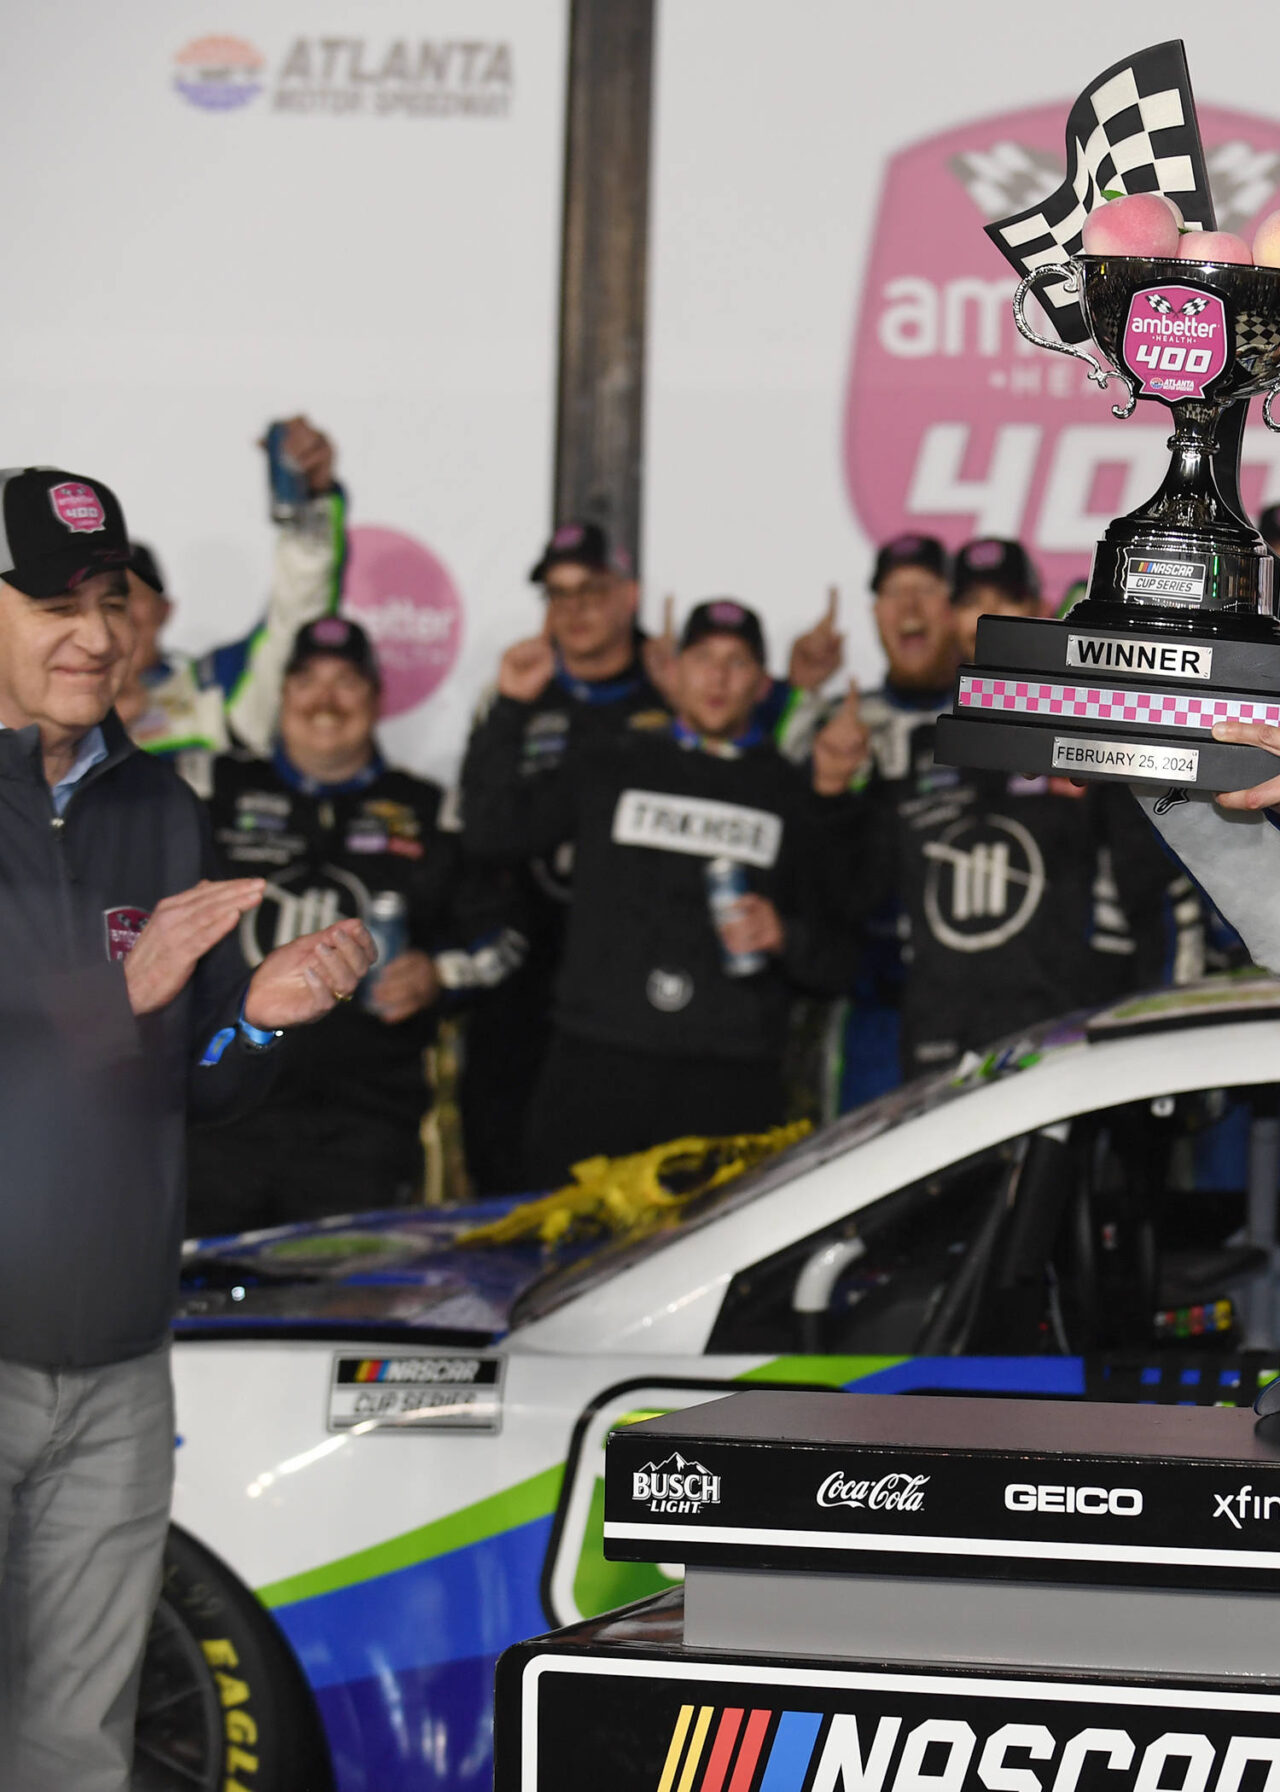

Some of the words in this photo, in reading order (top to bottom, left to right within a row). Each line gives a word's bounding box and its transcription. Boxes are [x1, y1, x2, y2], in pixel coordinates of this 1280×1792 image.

[281, 38, 513, 84] ATLANTA
[1131, 314, 1218, 338] ambetter
[1155, 335, 1194, 343] HEALTH
[1136, 344, 1212, 374] 400
[1150, 562, 1194, 577] NASCAR
[1135, 578, 1156, 589] CUP
[1156, 580, 1193, 592] SERIES
[1077, 640, 1201, 674] WINNER
[1057, 746, 1136, 766] FEBRUARY
[1138, 754, 1159, 771] 25,
[1162, 756, 1194, 772] 2024
[384, 1359, 481, 1383] NASCAR
[632, 1472, 722, 1505] BUSCH
[816, 1470, 931, 1512] Coca-Cola
[1004, 1483, 1144, 1517] GEICO
[650, 1500, 700, 1514] LIGHT
